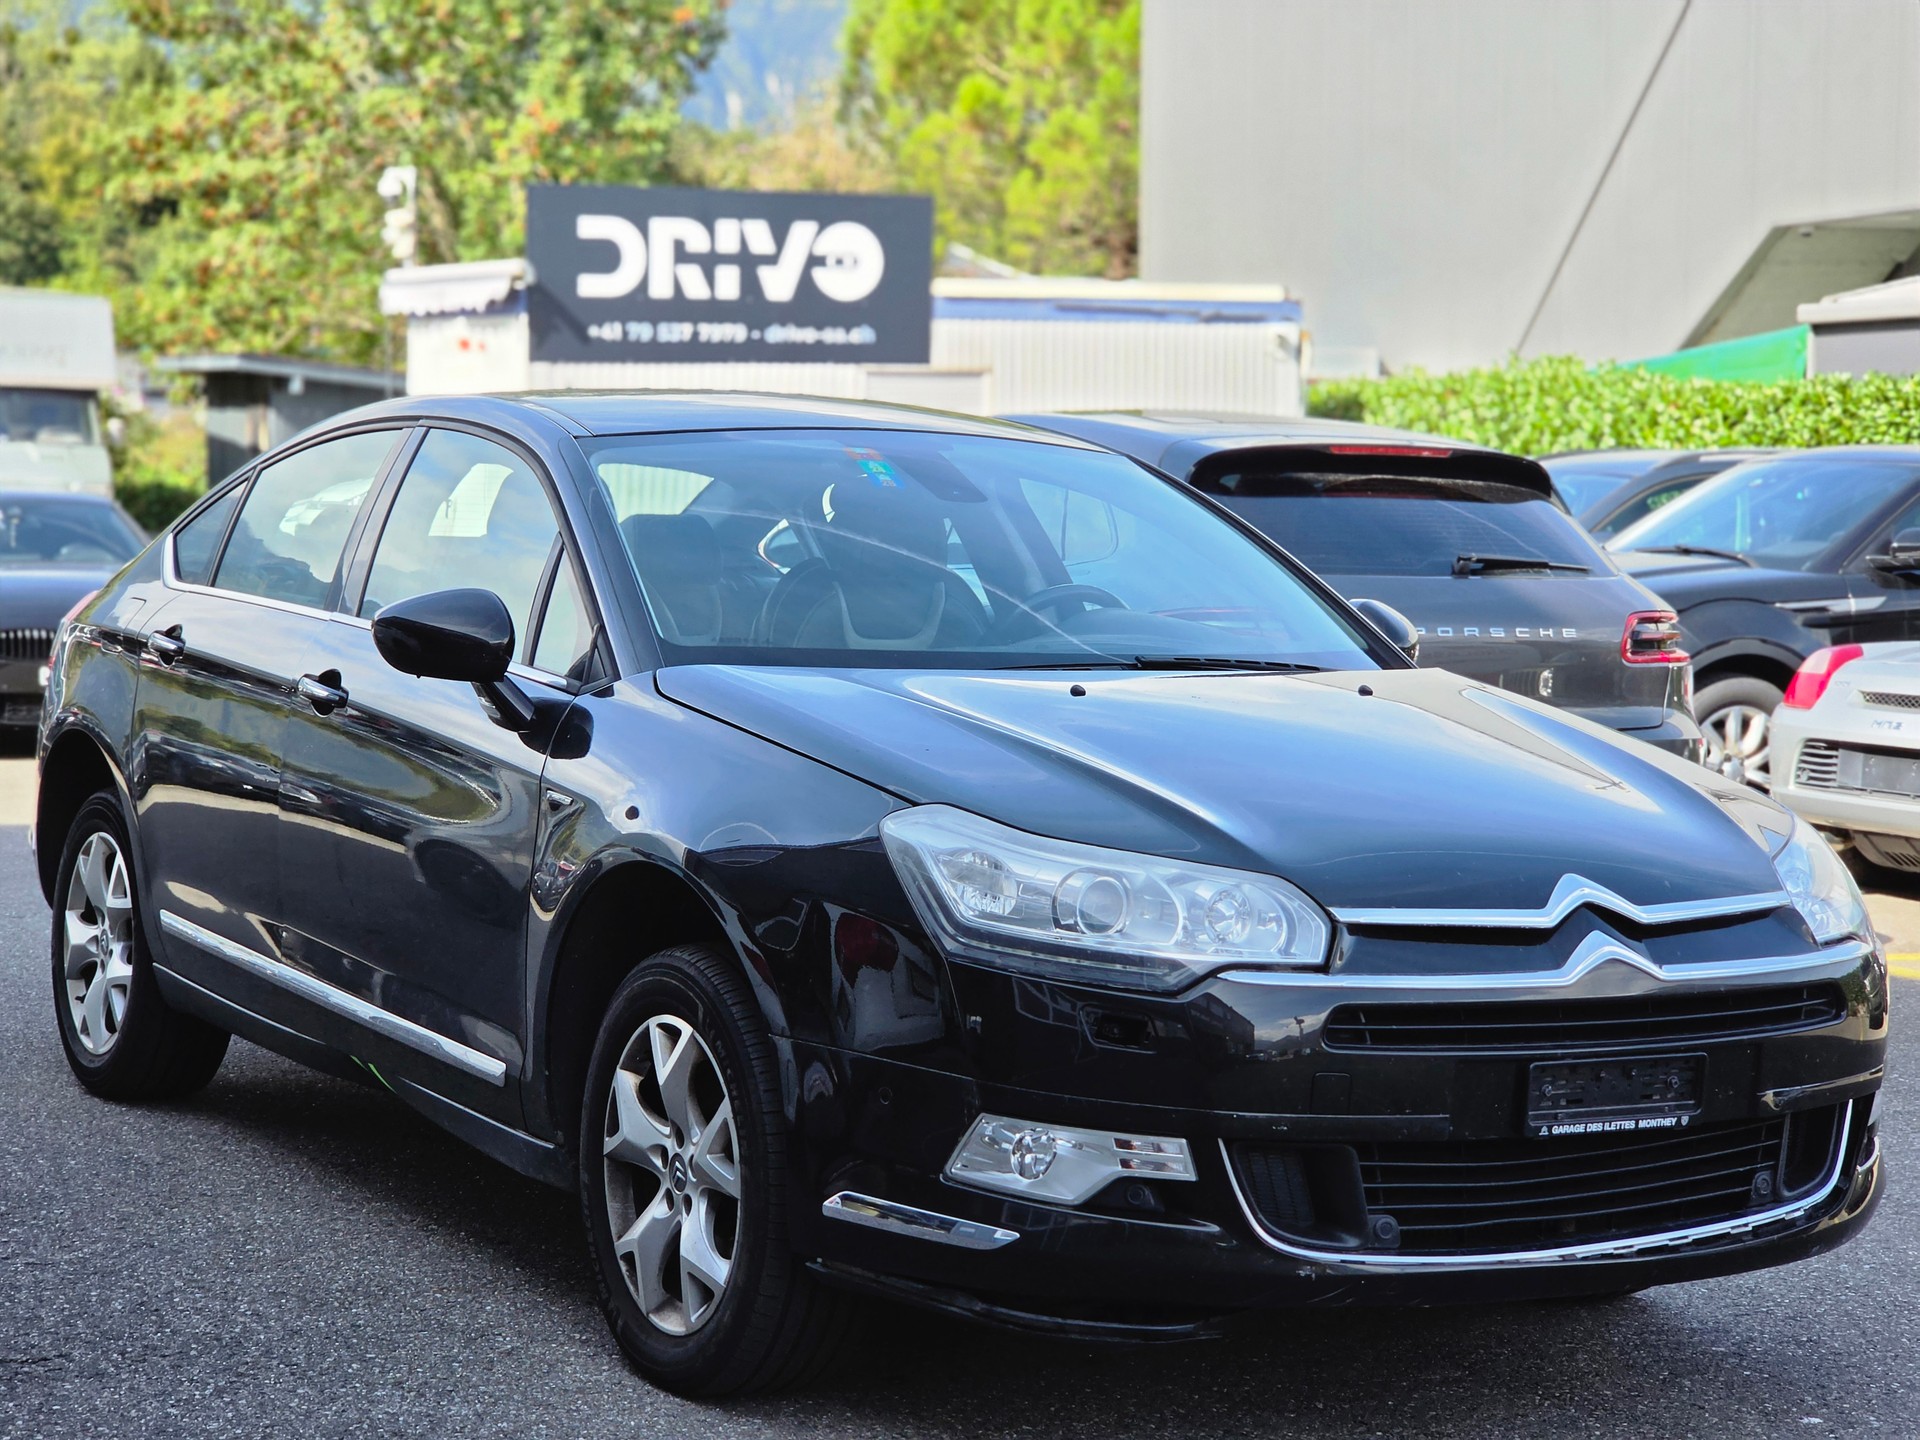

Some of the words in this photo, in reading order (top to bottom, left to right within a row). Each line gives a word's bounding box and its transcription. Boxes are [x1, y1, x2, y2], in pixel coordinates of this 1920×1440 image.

[576, 213, 885, 302] DRIVO
[1551, 1124, 1585, 1135] GARAGE
[1586, 1122, 1603, 1132] DES
[1604, 1120, 1636, 1131] ILETTES
[1638, 1117, 1678, 1128] MONTHEY
